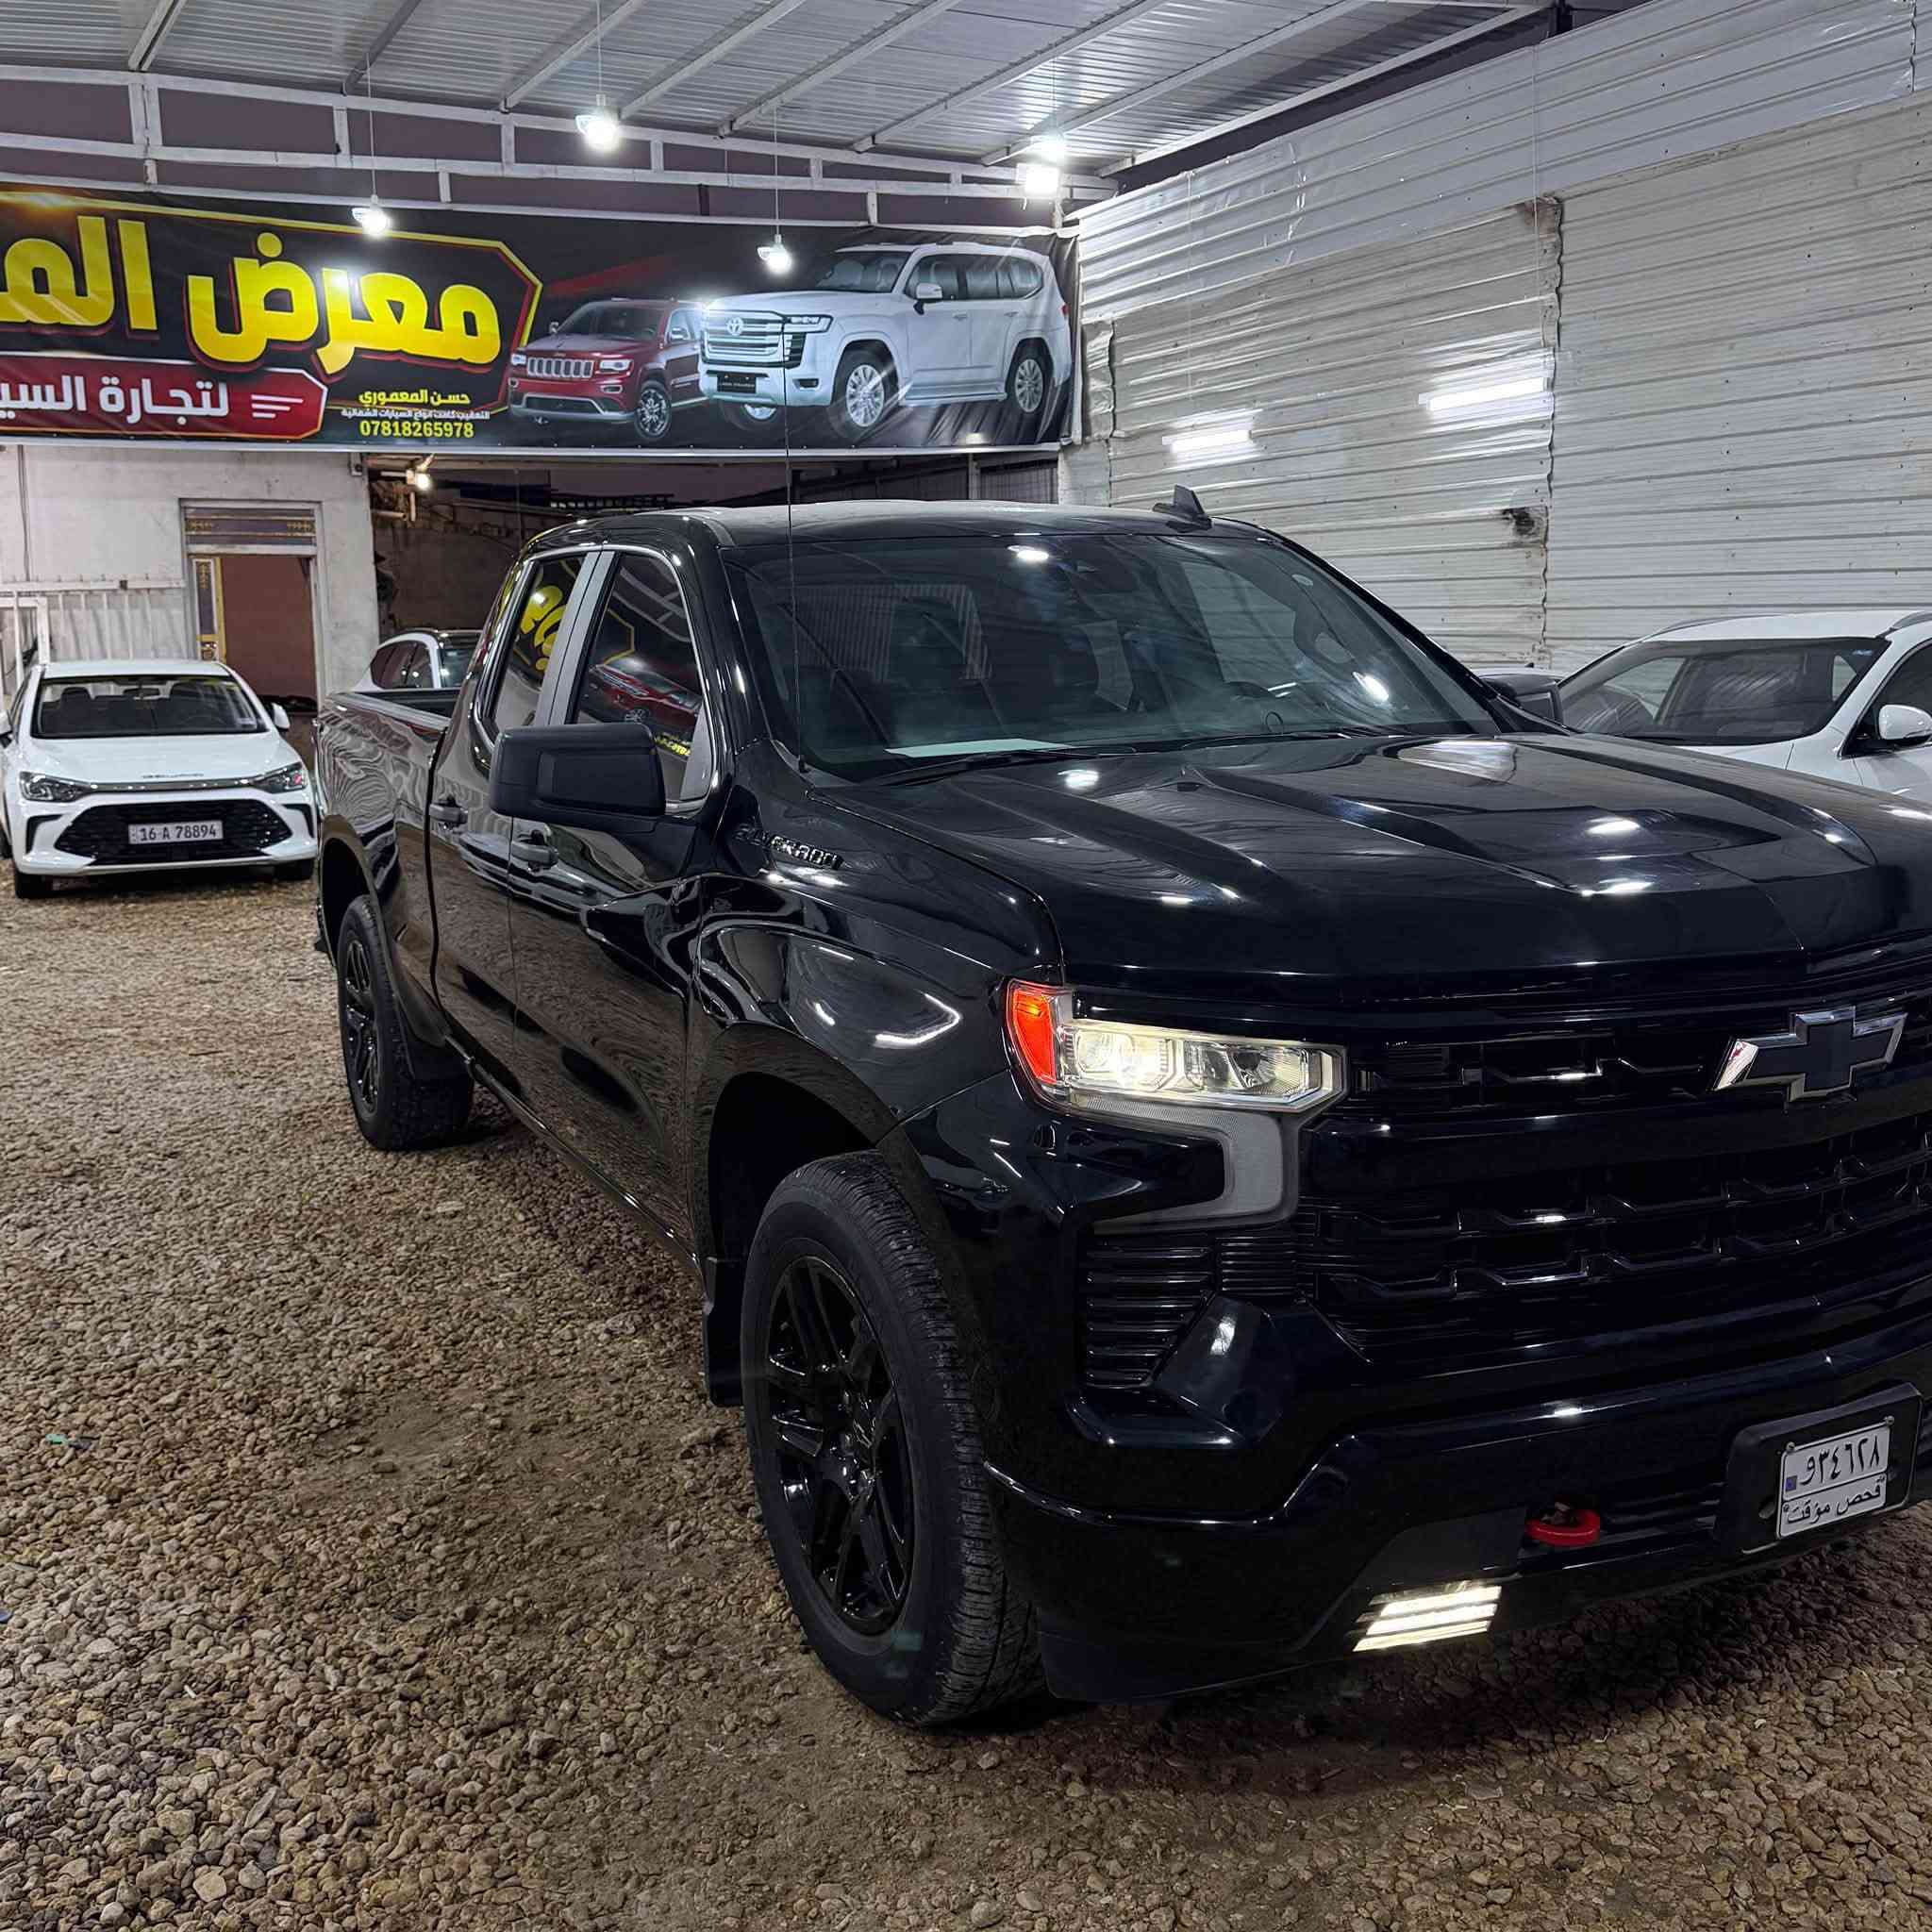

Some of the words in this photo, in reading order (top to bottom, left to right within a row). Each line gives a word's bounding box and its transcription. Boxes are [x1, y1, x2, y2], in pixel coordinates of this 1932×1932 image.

[187, 232, 502, 375] معرض
[99, 376, 229, 425] لتجارة
[358, 389, 428, 408] المعموري
[430, 391, 471, 406] حسن
[359, 420, 475, 439] 07818265978
[139, 827, 157, 841] 16
[162, 826, 171, 840] A
[175, 824, 217, 839] 78894
[1837, 1475, 1886, 1515] فحص
[1787, 1499, 1831, 1524] مؤقت
